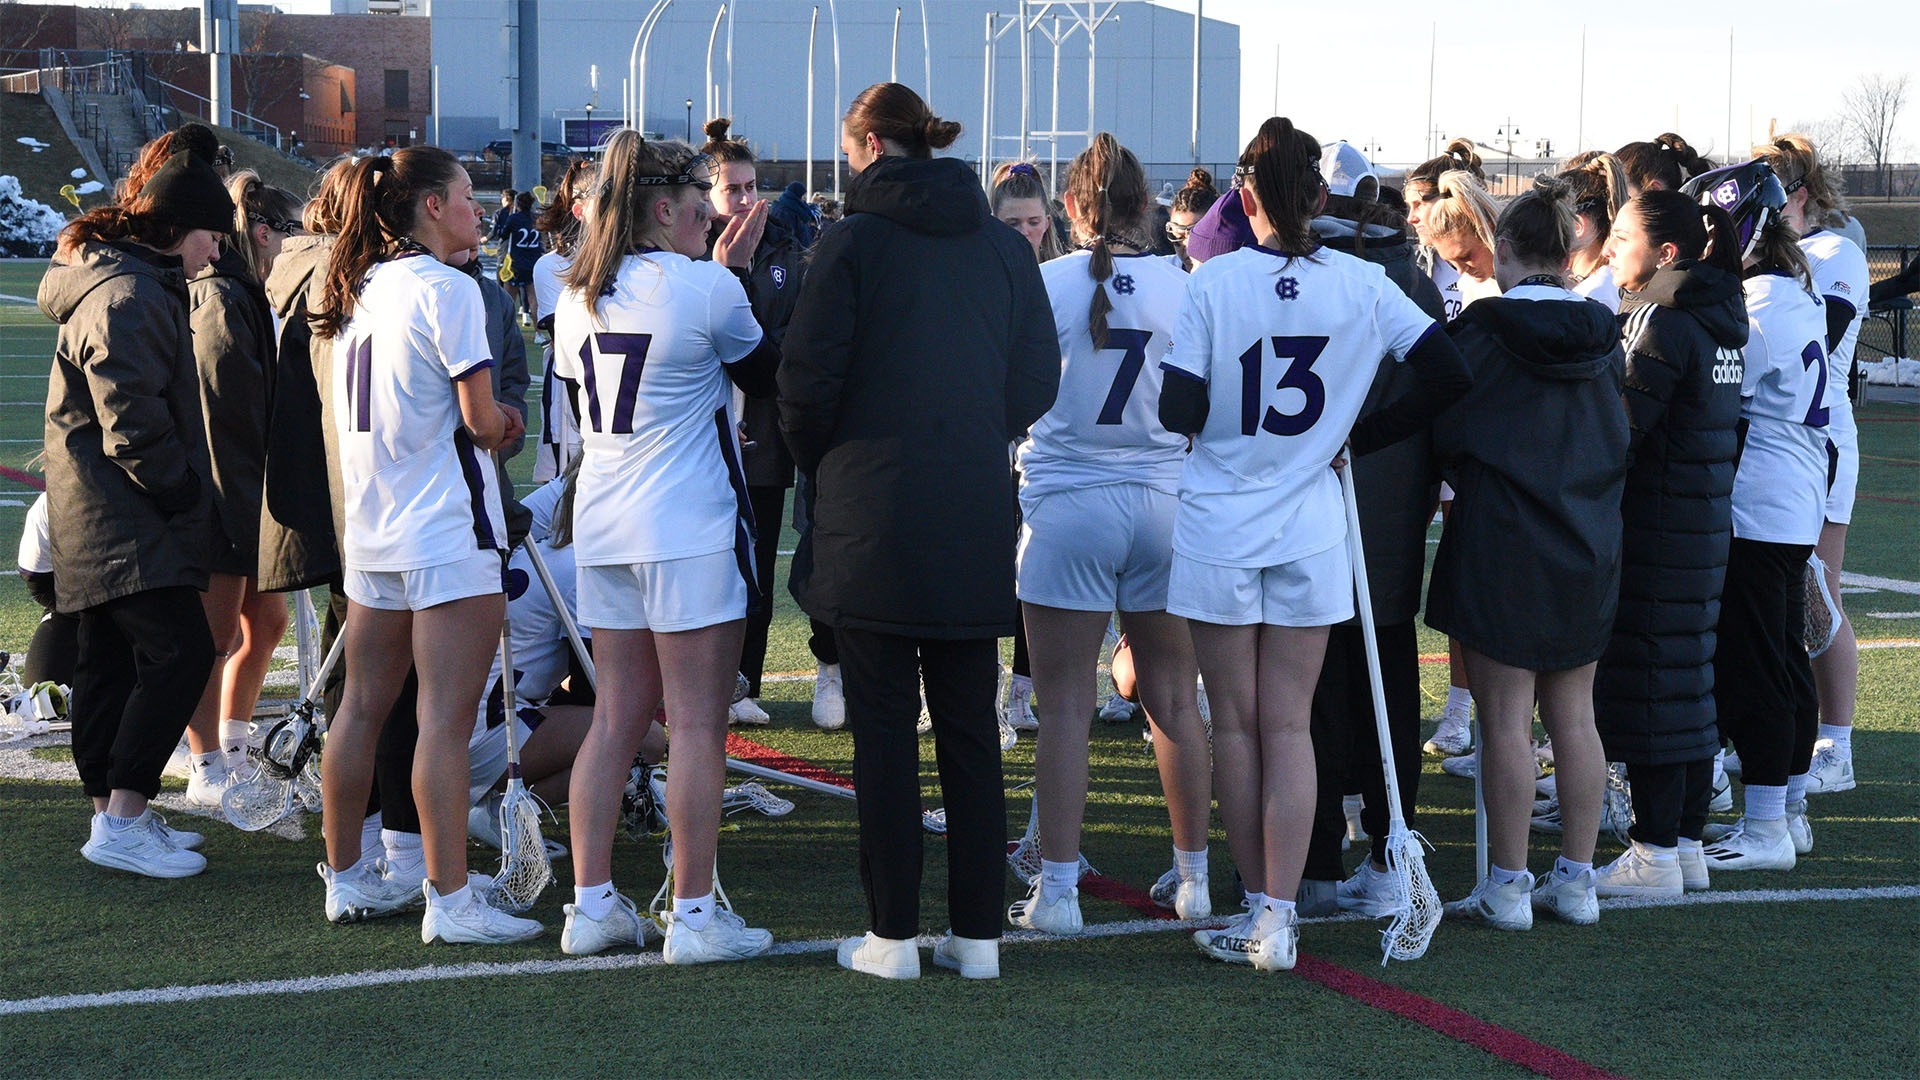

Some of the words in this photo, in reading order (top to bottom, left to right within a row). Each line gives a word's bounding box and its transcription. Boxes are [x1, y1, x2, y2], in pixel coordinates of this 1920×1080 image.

[640, 176, 669, 185] STX
[516, 228, 539, 248] 22
[346, 333, 372, 432] 11
[578, 332, 653, 434] 17
[1095, 327, 1153, 425] 7
[1238, 336, 1331, 437] 13
[1713, 359, 1742, 384] adidas
[1209, 935, 1261, 954] ADIZERO
